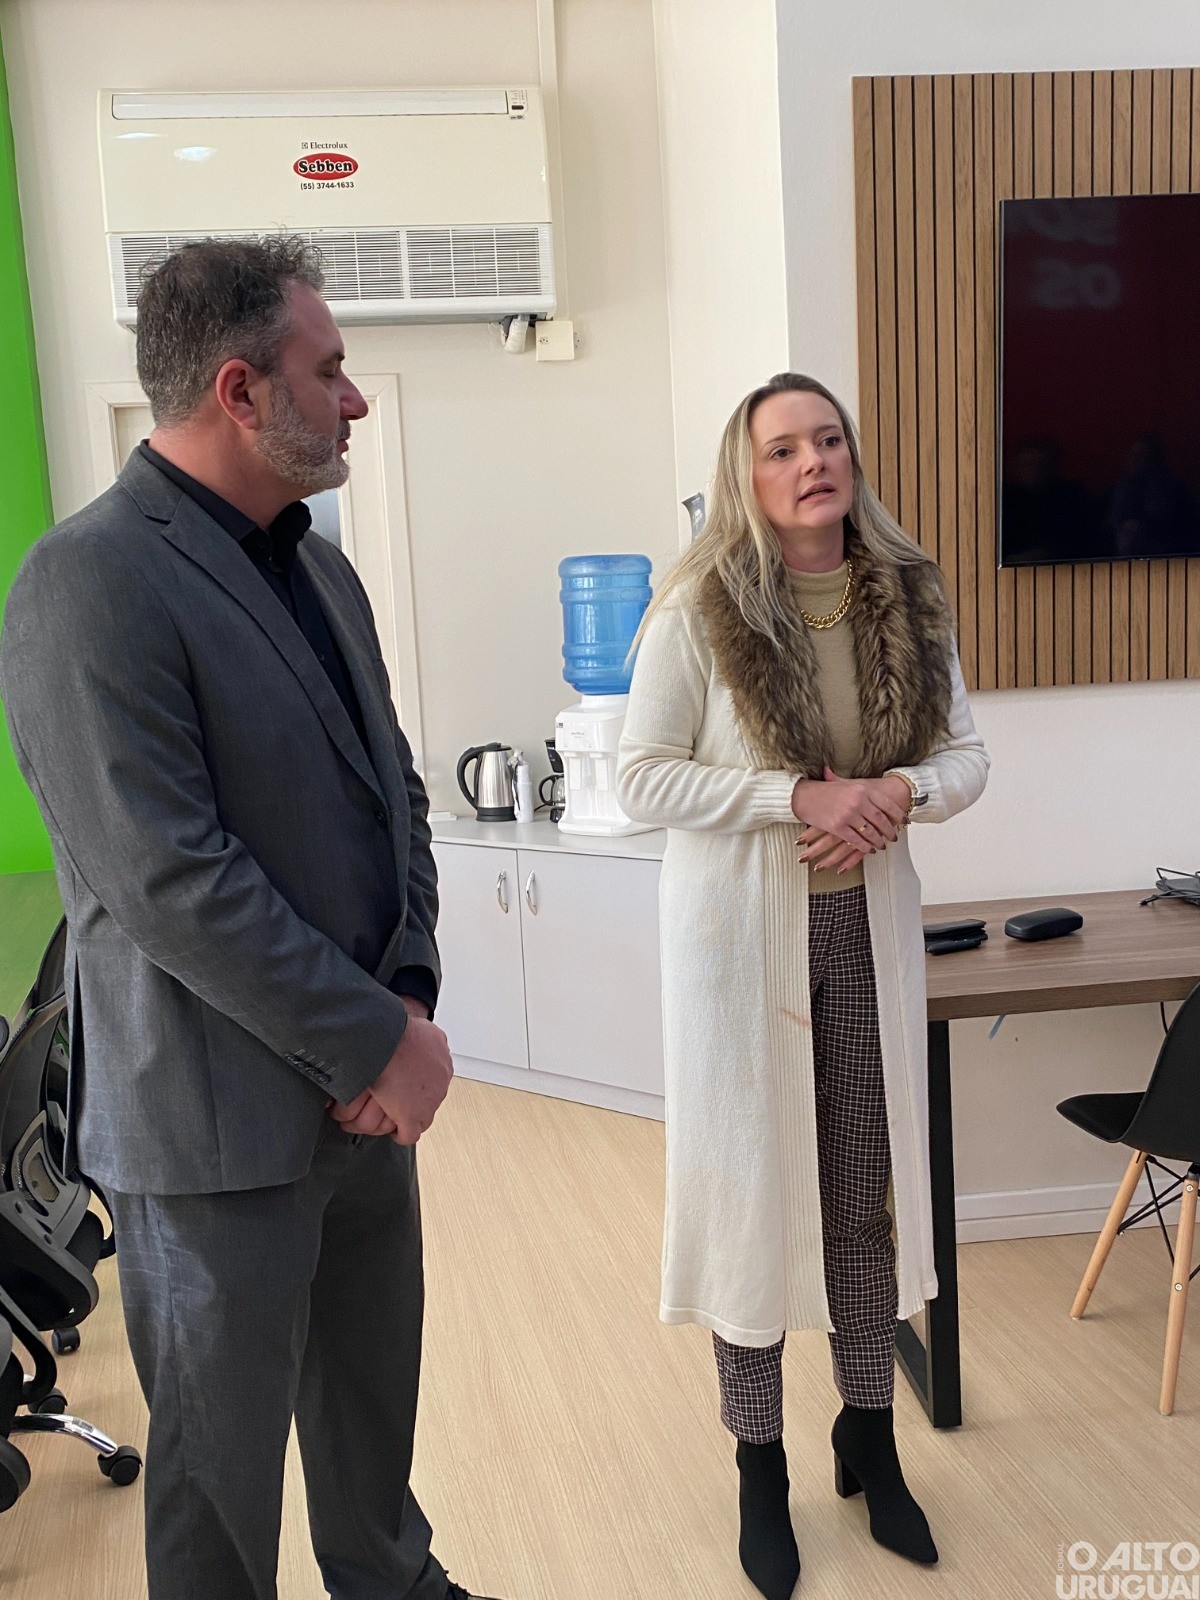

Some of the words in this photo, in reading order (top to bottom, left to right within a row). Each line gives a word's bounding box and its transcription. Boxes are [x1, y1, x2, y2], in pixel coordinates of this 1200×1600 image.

[310, 141, 348, 149] Electrolux
[298, 160, 353, 173] Sebben
[300, 182, 315, 191] (55)
[316, 181, 355, 190] 3744-1633
